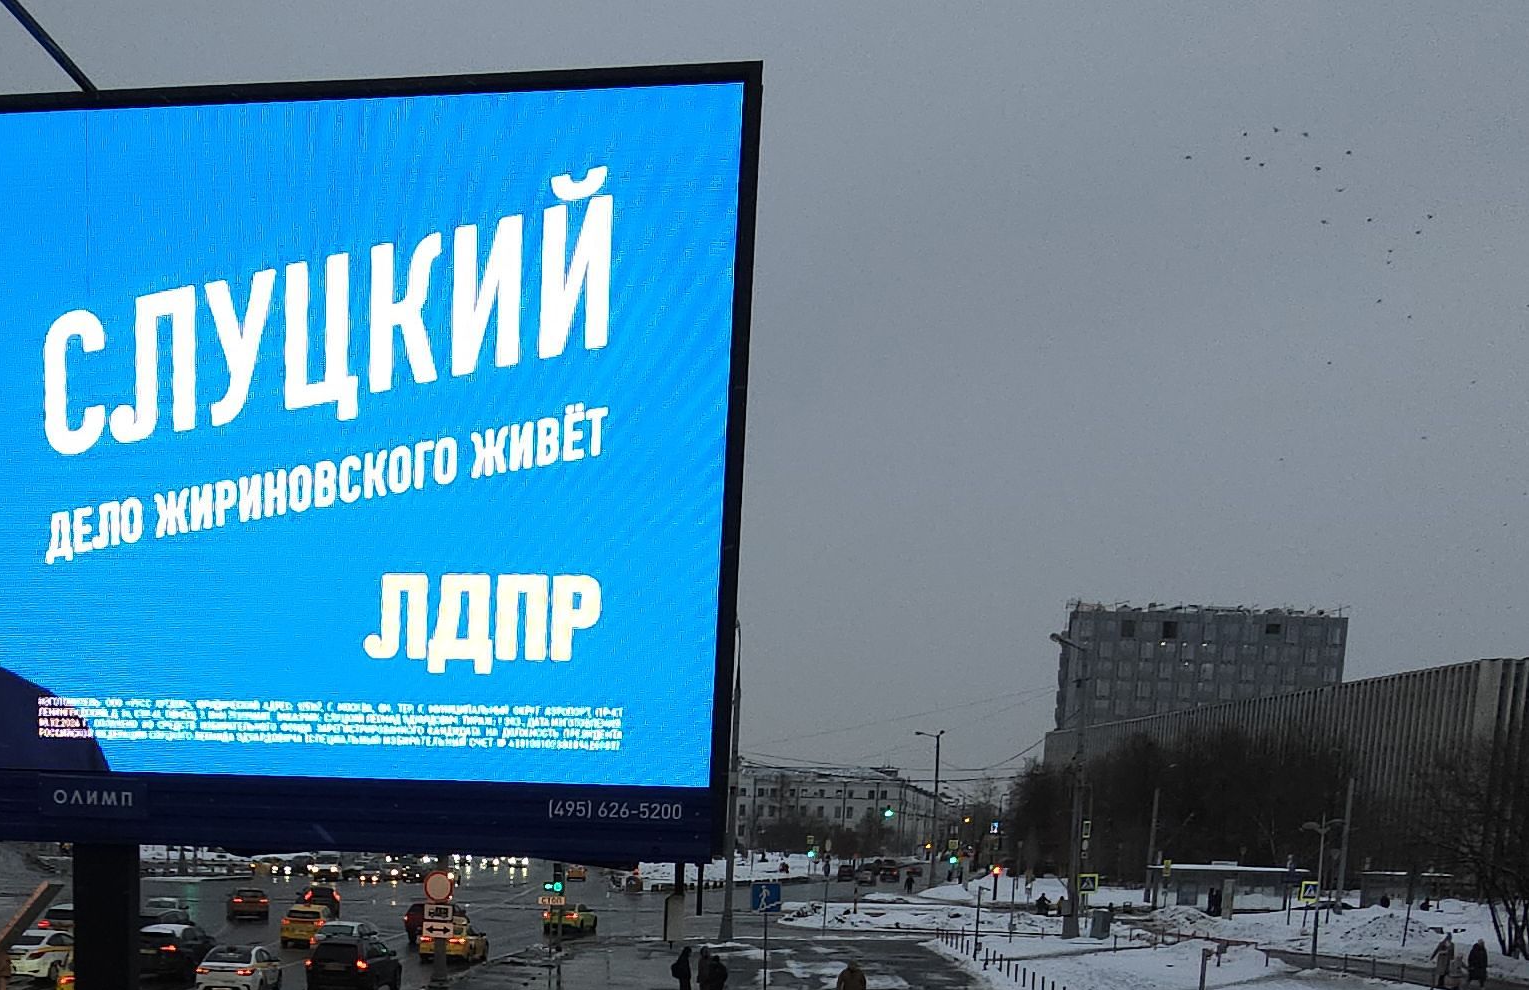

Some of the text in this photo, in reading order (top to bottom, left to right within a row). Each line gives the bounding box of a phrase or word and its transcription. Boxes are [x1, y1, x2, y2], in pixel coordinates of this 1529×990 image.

[43, 166, 613, 456] СЛУЦКИЙ
[45, 402, 609, 565] ДЕЛО ЖИРИНОВСКОГО ЖИВЁТ
[363, 573, 602, 674] ЛДПР
[53, 789, 133, 807] ОЛИМП
[548, 799, 683, 820] (495) 626-5200
